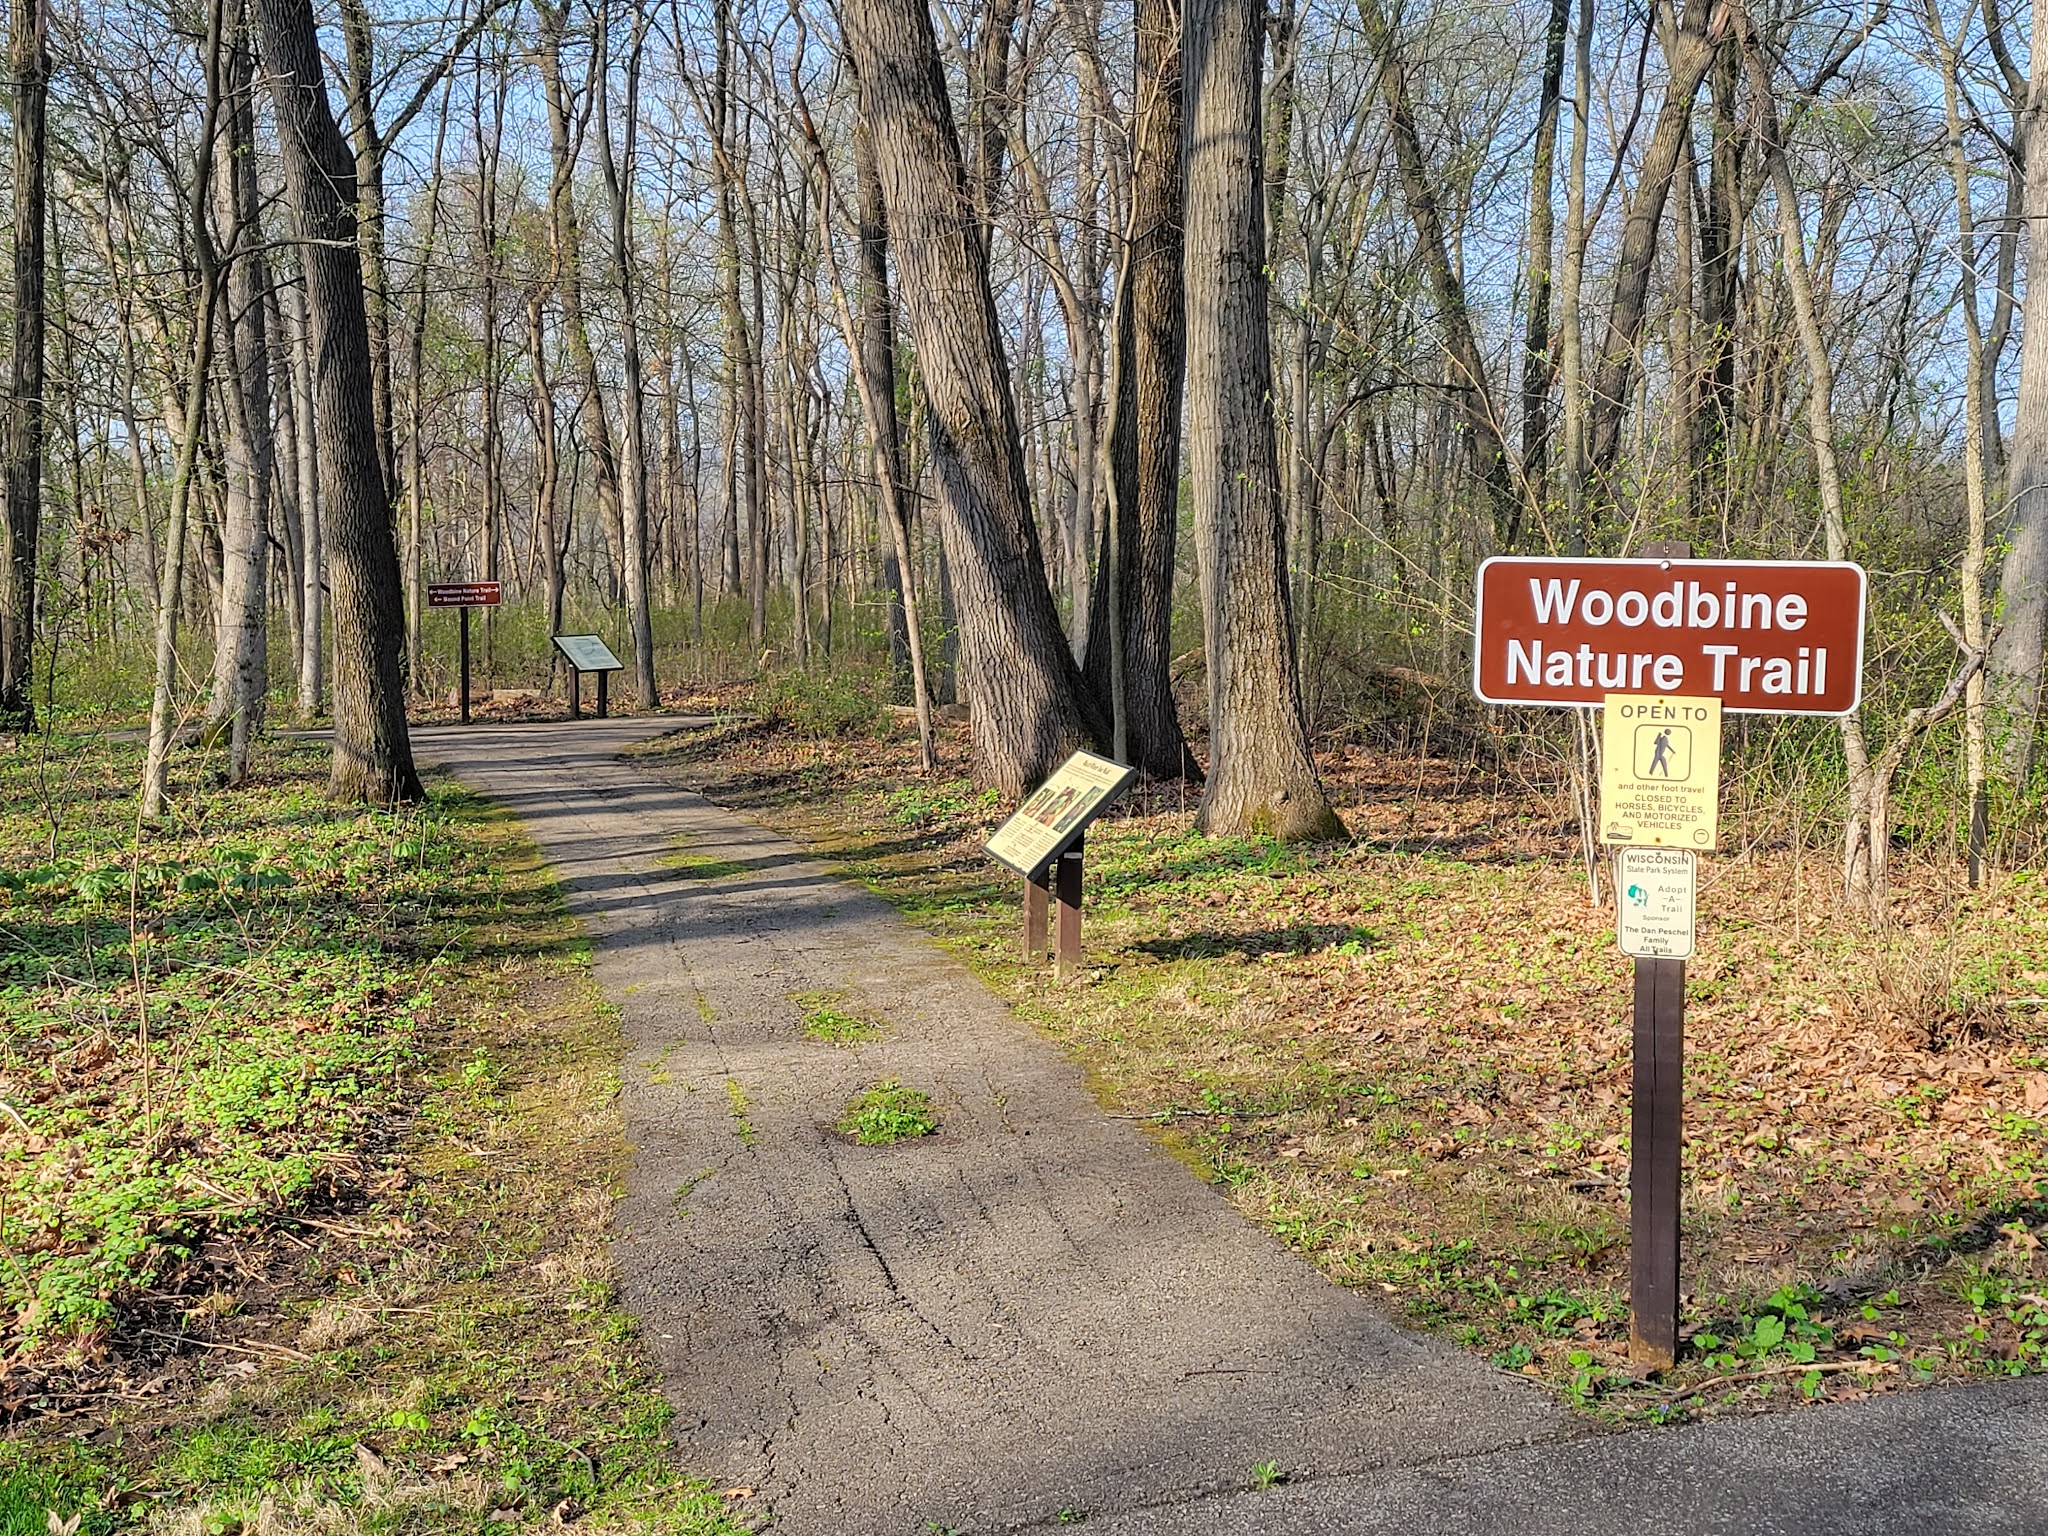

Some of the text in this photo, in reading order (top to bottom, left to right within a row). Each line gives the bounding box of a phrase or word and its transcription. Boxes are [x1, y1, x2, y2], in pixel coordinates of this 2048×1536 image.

[1529, 578, 1809, 631] Woodbine
[1506, 639, 1828, 695] Nature Trail
[1620, 704, 1708, 721] OPEN TO
[1636, 783, 1659, 792] other
[1661, 784, 1679, 792] foot
[1680, 785, 1705, 793] travel
[1634, 794, 1672, 803] CLOSED
[1615, 802, 1705, 814] HORSES, BICYCLES,
[1622, 811, 1698, 822] AND MOTORIZED
[1637, 821, 1682, 829] VEHICLES
[1626, 854, 1689, 865] WISCONSIN
[1646, 866, 1661, 874] Park
[1662, 867, 1689, 875] System
[1658, 886, 1687, 894] Adopt
[1661, 905, 1683, 913] Trail
[1658, 928, 1689, 936] Peschel
[1643, 936, 1669, 945] Family
